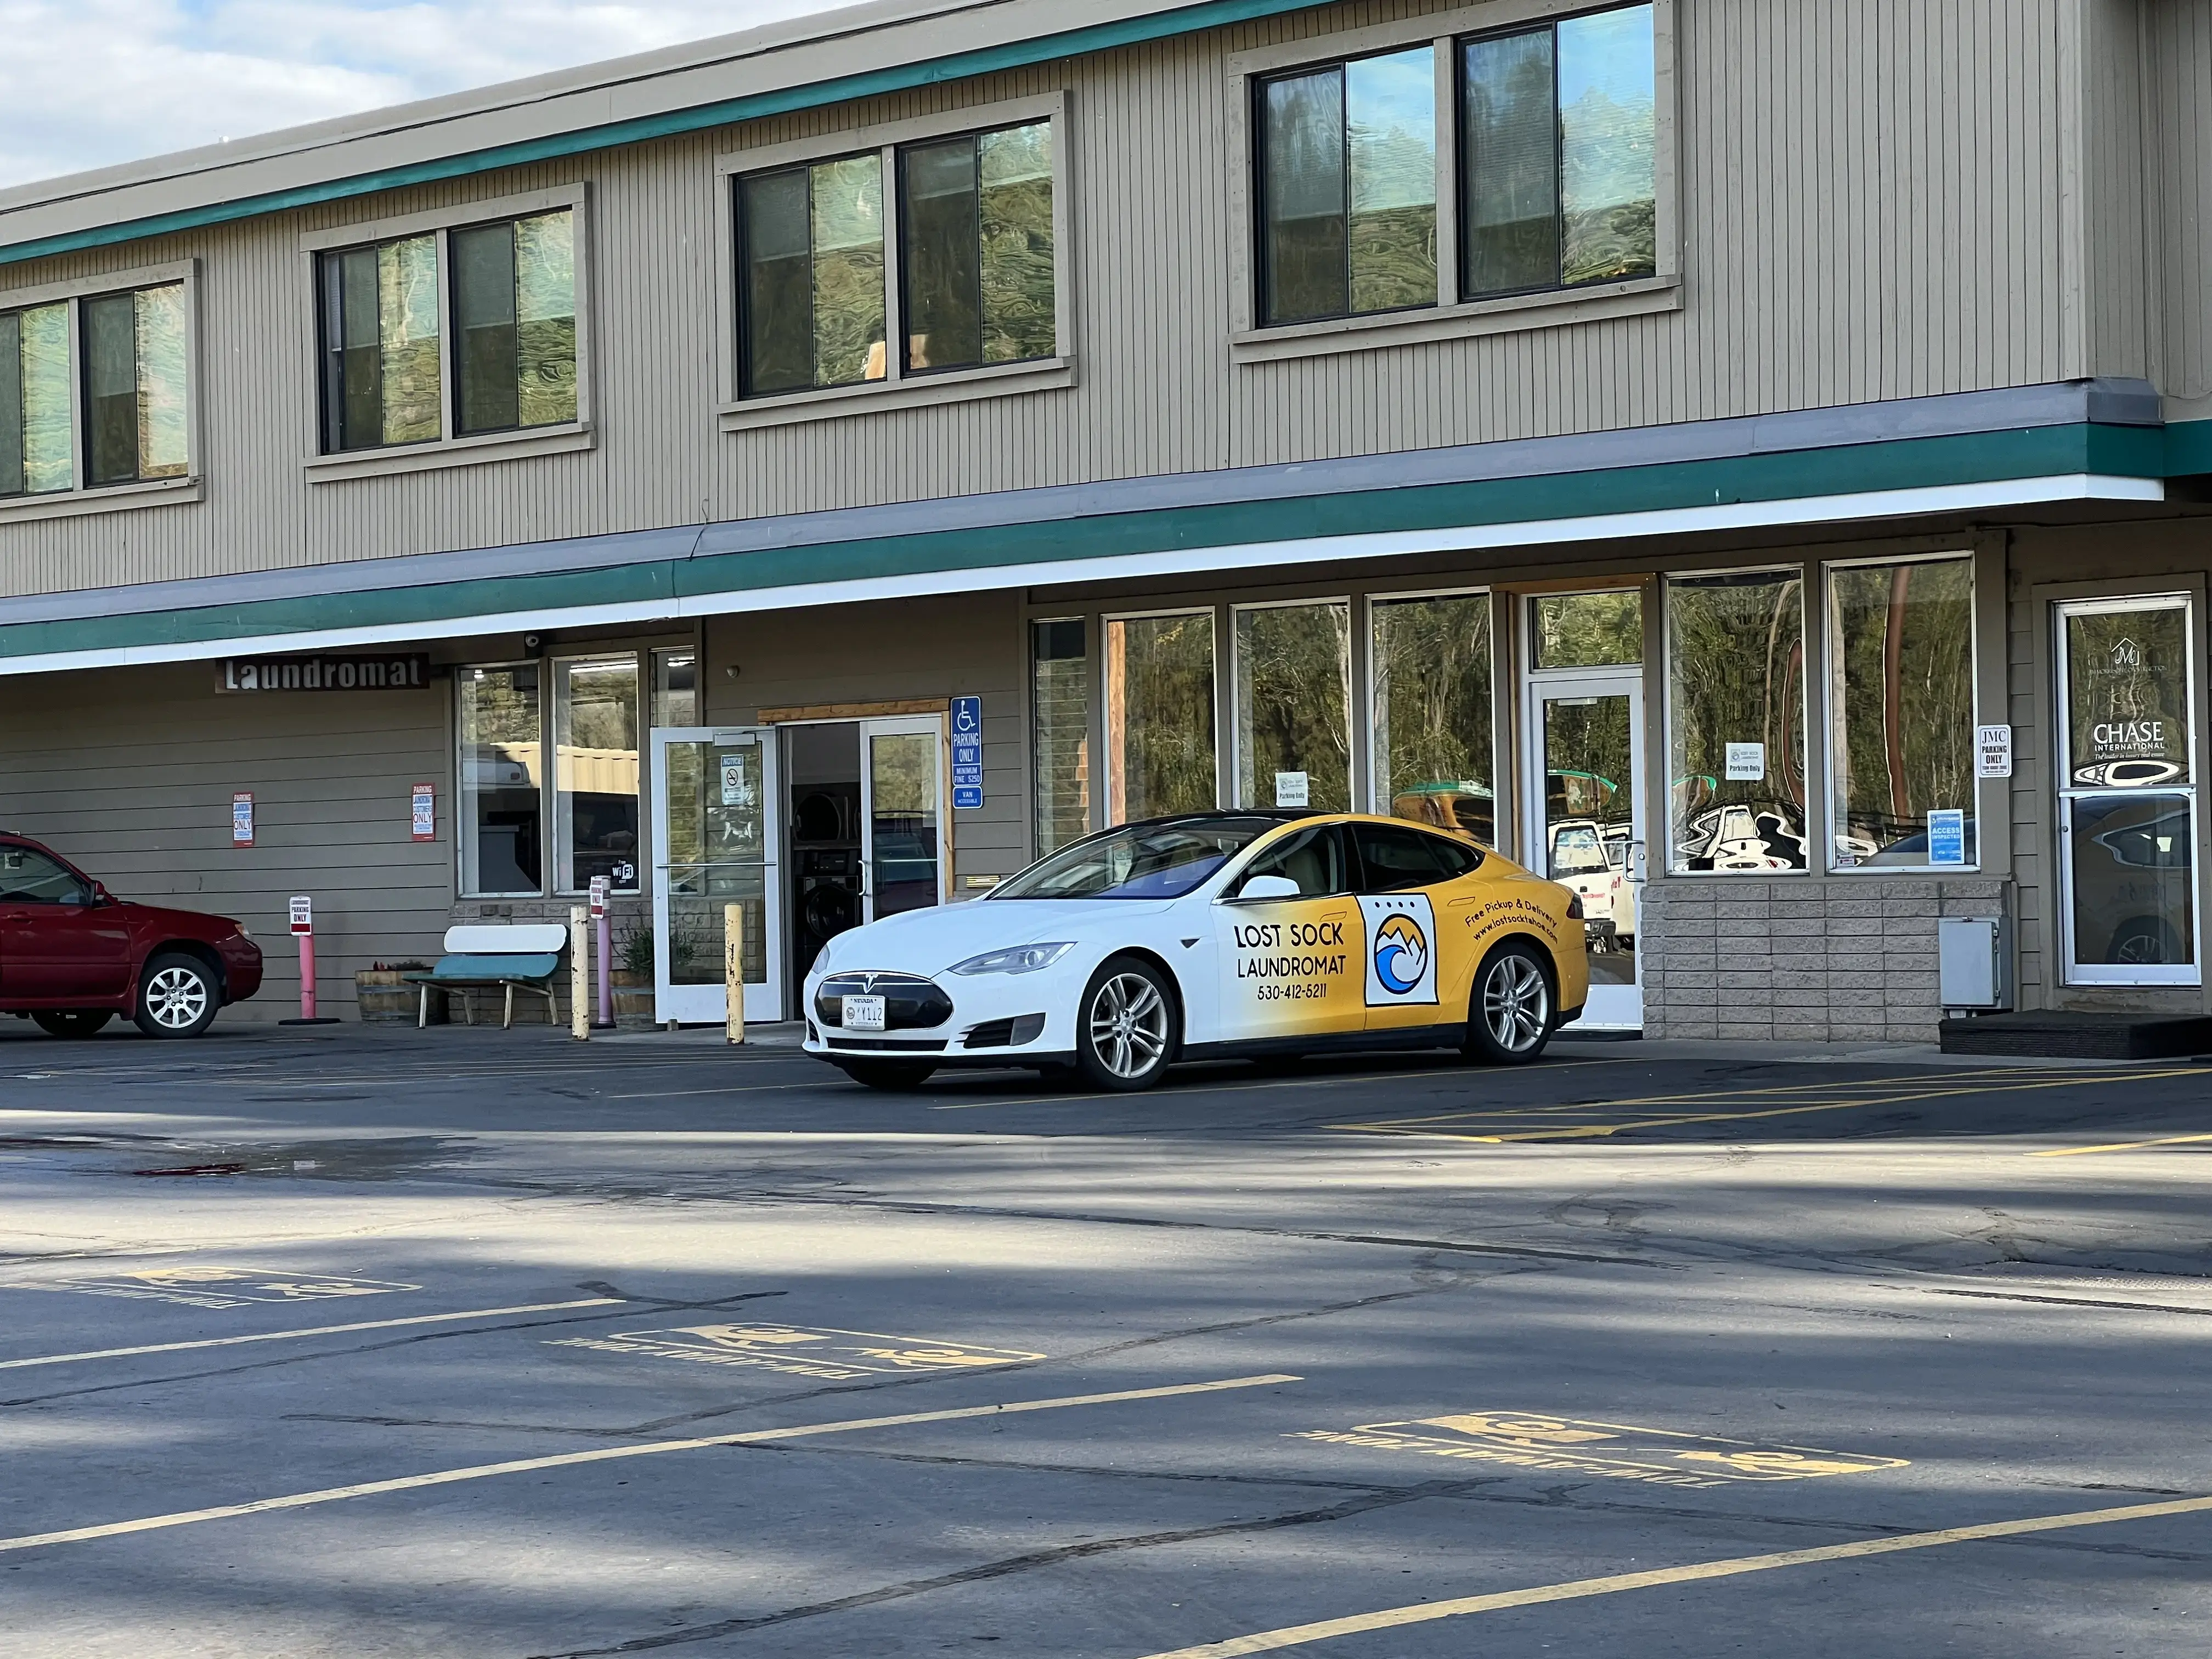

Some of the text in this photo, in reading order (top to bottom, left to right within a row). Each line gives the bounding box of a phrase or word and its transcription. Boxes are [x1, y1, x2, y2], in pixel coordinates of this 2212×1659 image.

[225, 659, 421, 690] Laundromat
[953, 733, 978, 747] PARKING
[1982, 731, 2006, 744] JMC
[2094, 721, 2164, 744] CHASE
[2095, 742, 2165, 752] INTERNATIONAL
[723, 758, 741, 766] NOTICE
[959, 748, 974, 762] ONLY
[1986, 755, 2002, 764] ONLY
[414, 786, 432, 794] PARKING
[234, 820, 251, 830] ONLY
[414, 813, 432, 823] ONLY
[1465, 898, 1558, 928] Free Pickup & Delivery
[1234, 922, 1344, 948] LOST SOCK
[1473, 914, 1558, 944] www.lostsocktahoe.com
[1238, 955, 1346, 978] LAUNDROMAT
[1257, 983, 1327, 1000] 530-412-5211
[639, 1350, 873, 1380] TOW-AWAY
[1415, 1448, 1734, 1489] TOW-AWAY
